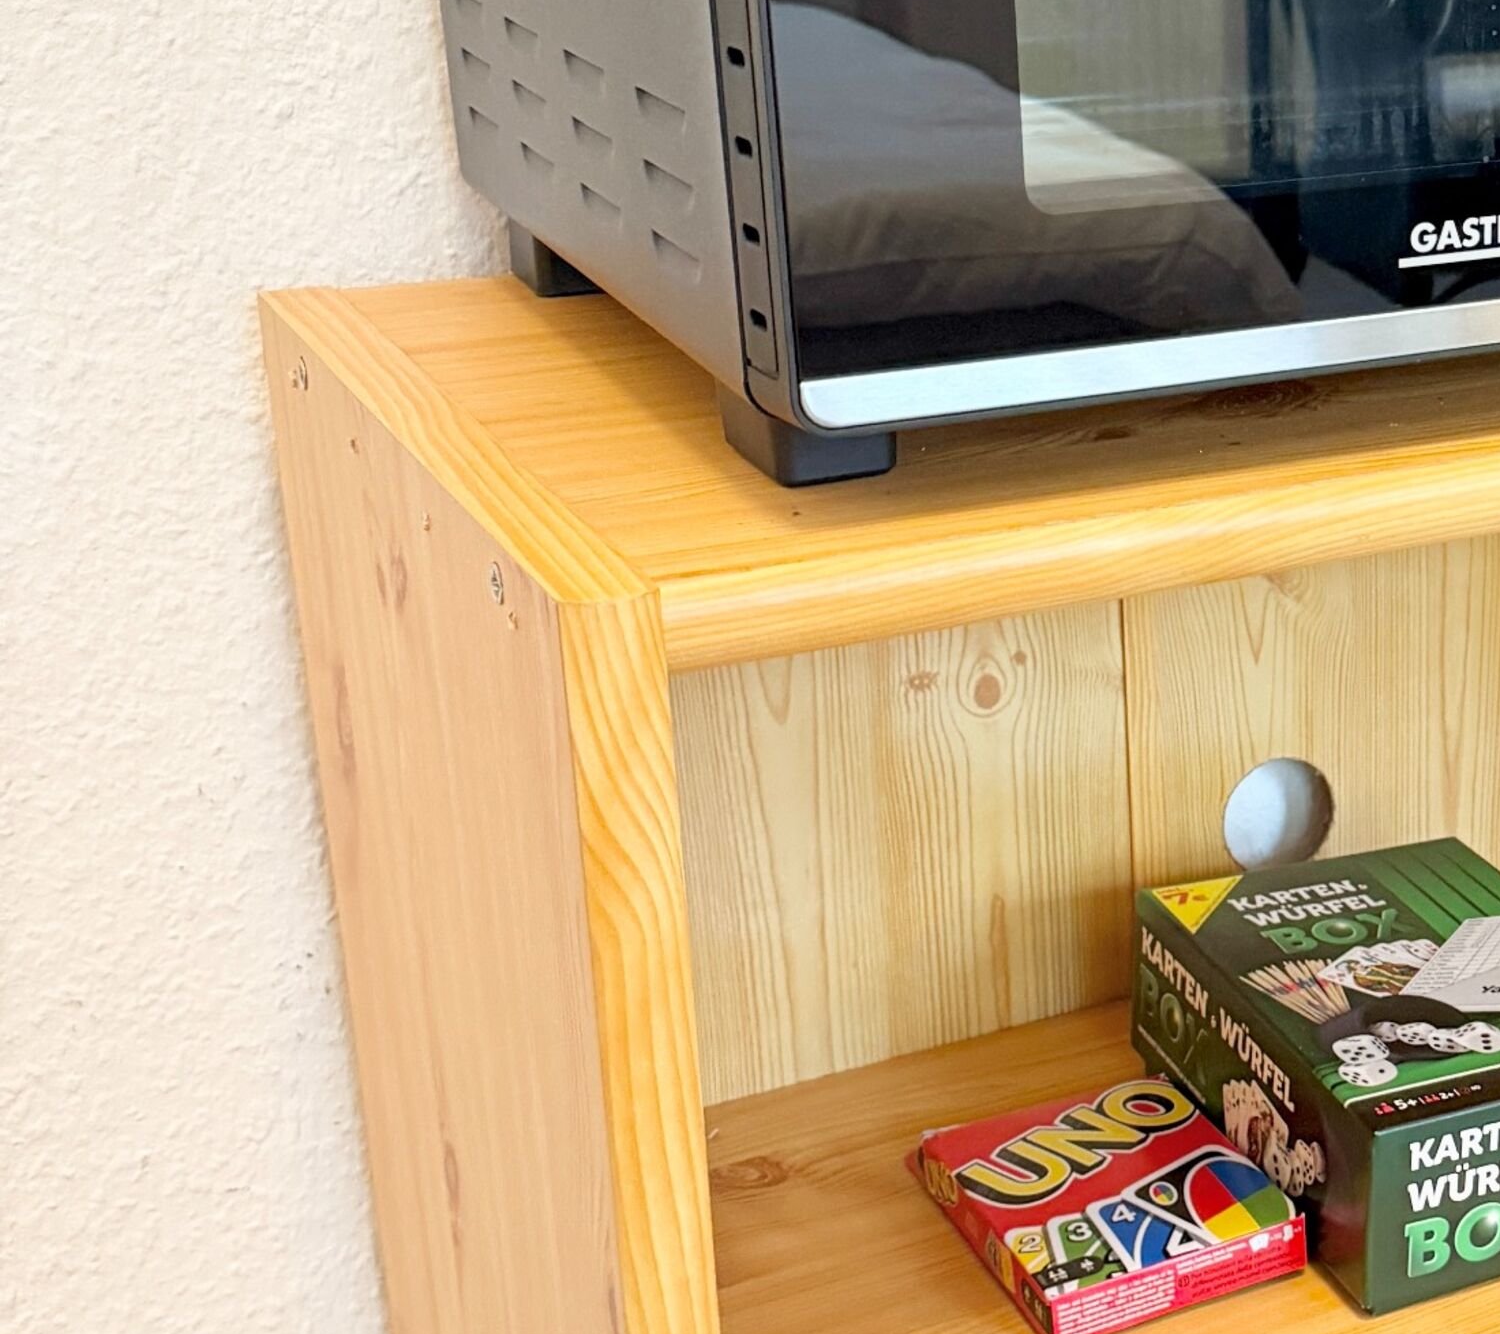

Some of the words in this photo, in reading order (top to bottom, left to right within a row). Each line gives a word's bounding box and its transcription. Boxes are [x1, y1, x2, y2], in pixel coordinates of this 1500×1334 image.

[1243, 894, 1387, 927] WÜRFEL
[1259, 908, 1412, 955] BOX
[1219, 1007, 1295, 1113] WÜRFEL
[956, 1082, 1198, 1207] UNO
[924, 1159, 957, 1207] UNO
[1066, 1222, 1092, 1241] 3
[1111, 1203, 1136, 1223] 4
[1018, 1234, 1043, 1253] 2
